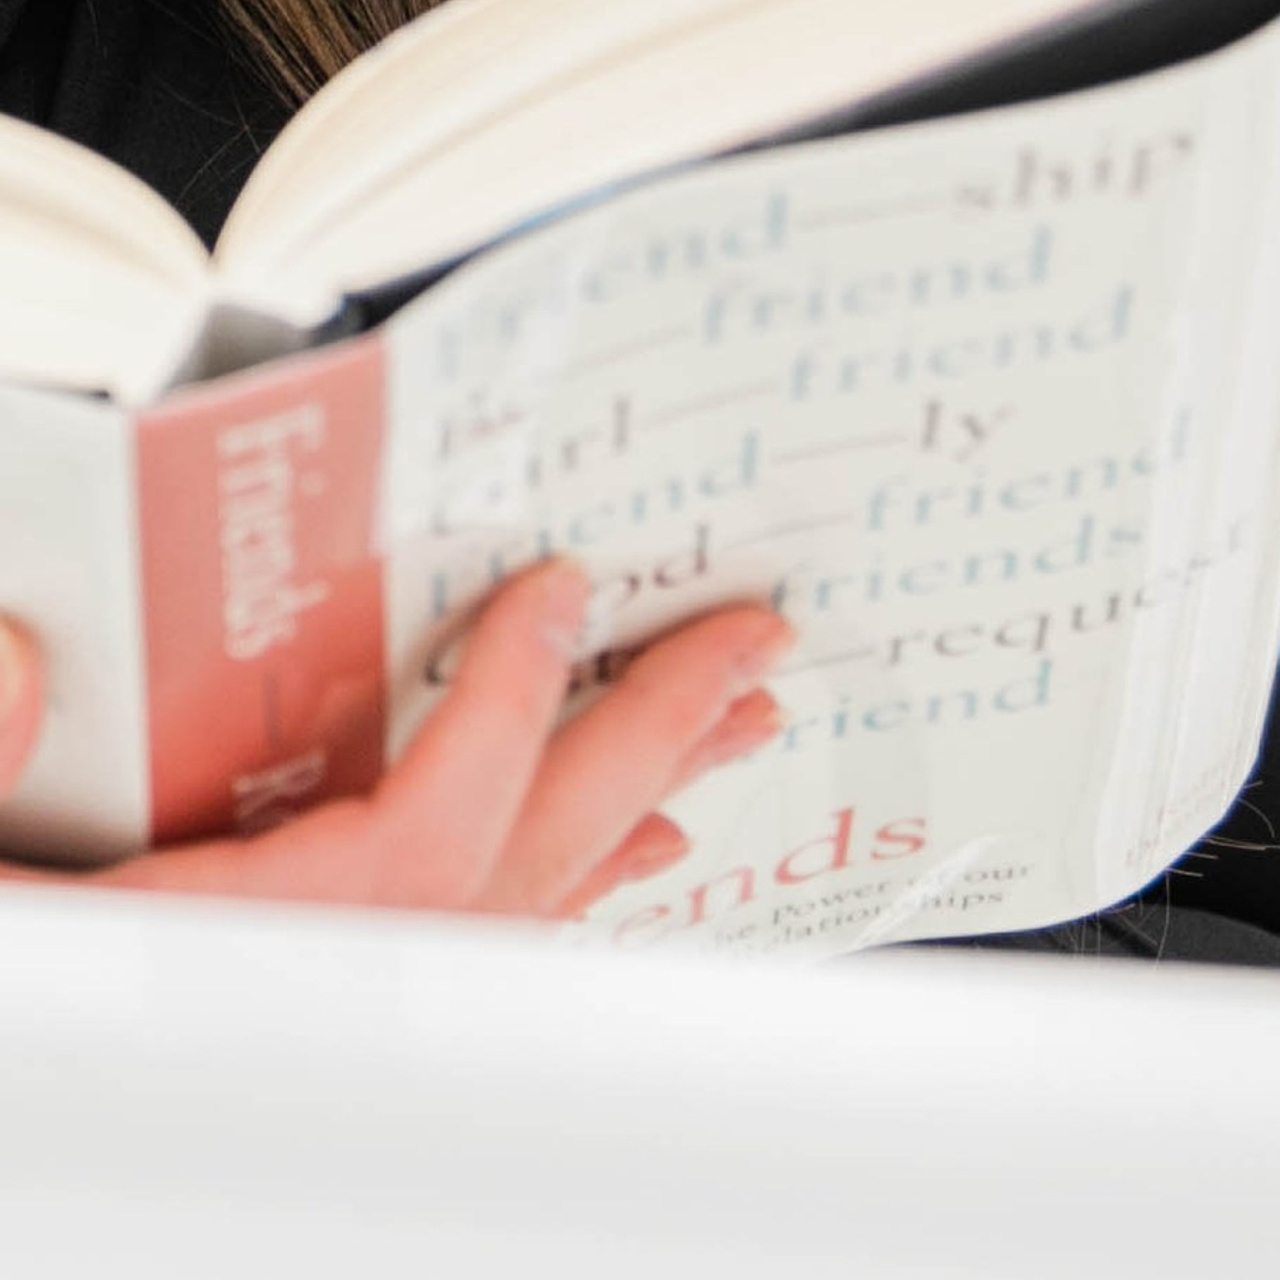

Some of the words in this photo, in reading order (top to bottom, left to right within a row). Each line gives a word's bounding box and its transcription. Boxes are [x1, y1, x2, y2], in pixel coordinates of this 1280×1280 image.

[700, 223, 1055, 346] friend
[786, 283, 1135, 402] friend
[918, 398, 1022, 464] ly
[780, 658, 1055, 755] riend
